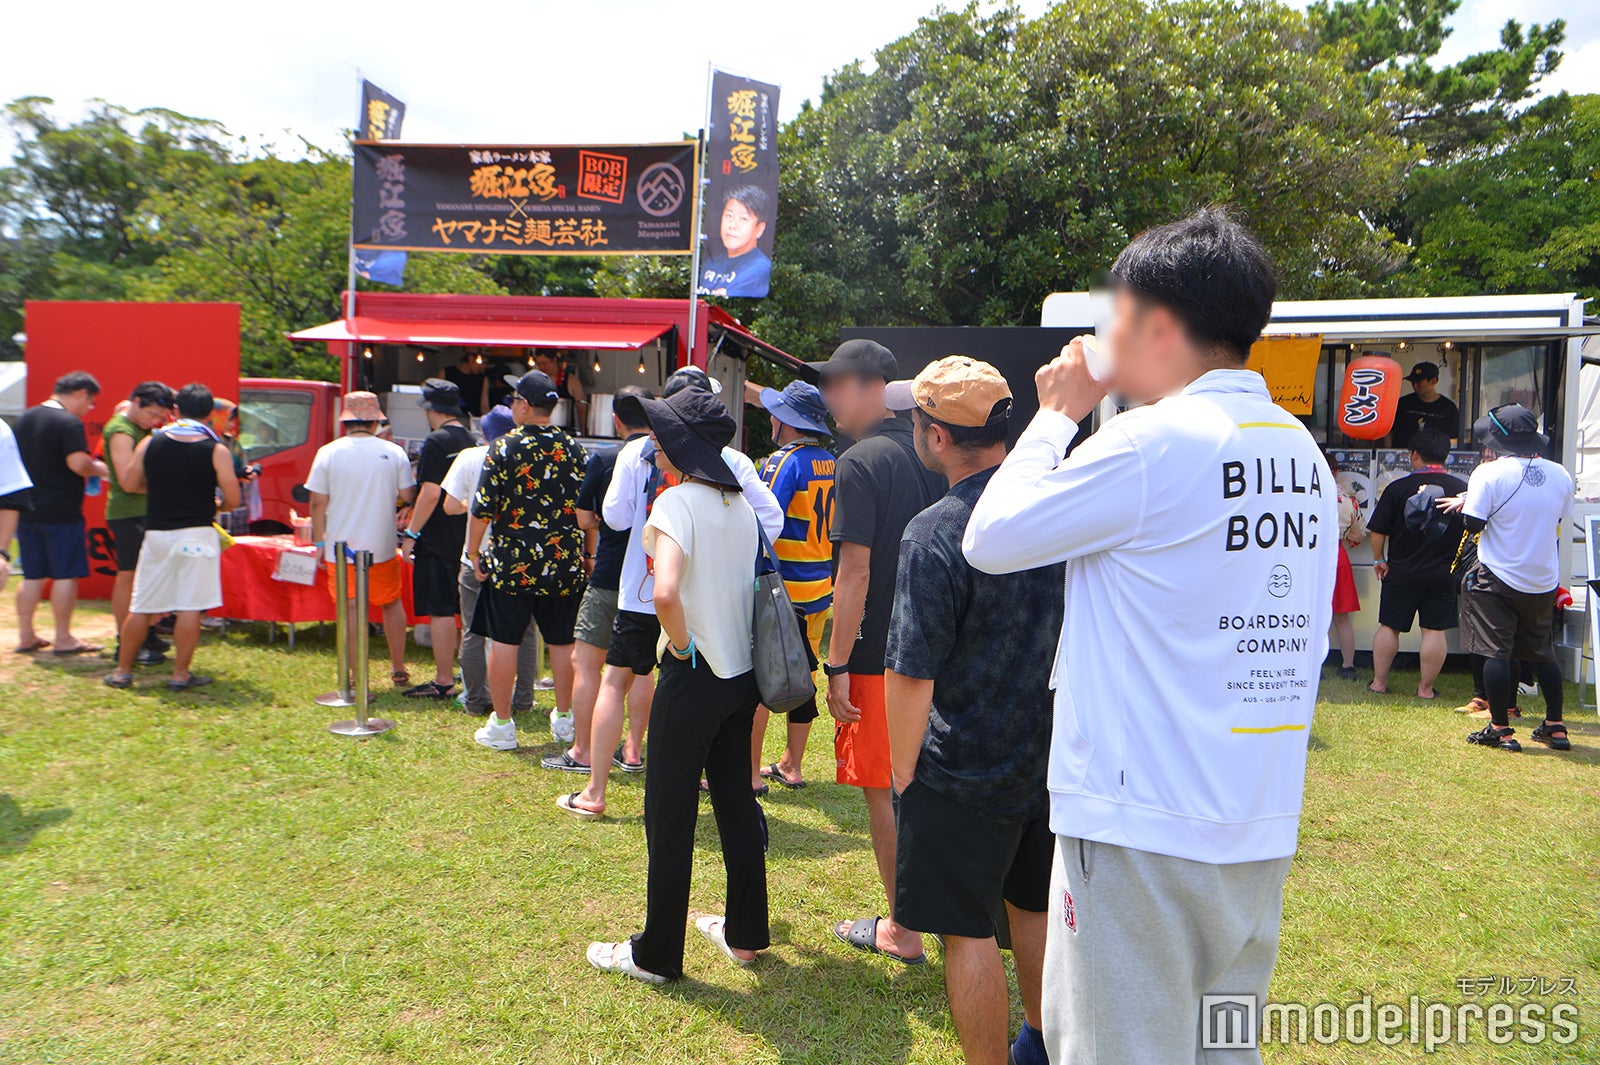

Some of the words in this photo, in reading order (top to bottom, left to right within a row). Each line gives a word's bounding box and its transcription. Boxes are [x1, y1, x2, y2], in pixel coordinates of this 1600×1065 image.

[469, 162, 559, 202] 堀江家
[585, 156, 622, 177] BOB
[583, 172, 620, 198] 限定
[1344, 369, 1384, 426] ラーメン
[1223, 458, 1321, 498] BILLA
[1227, 681, 1255, 690] SINCE
